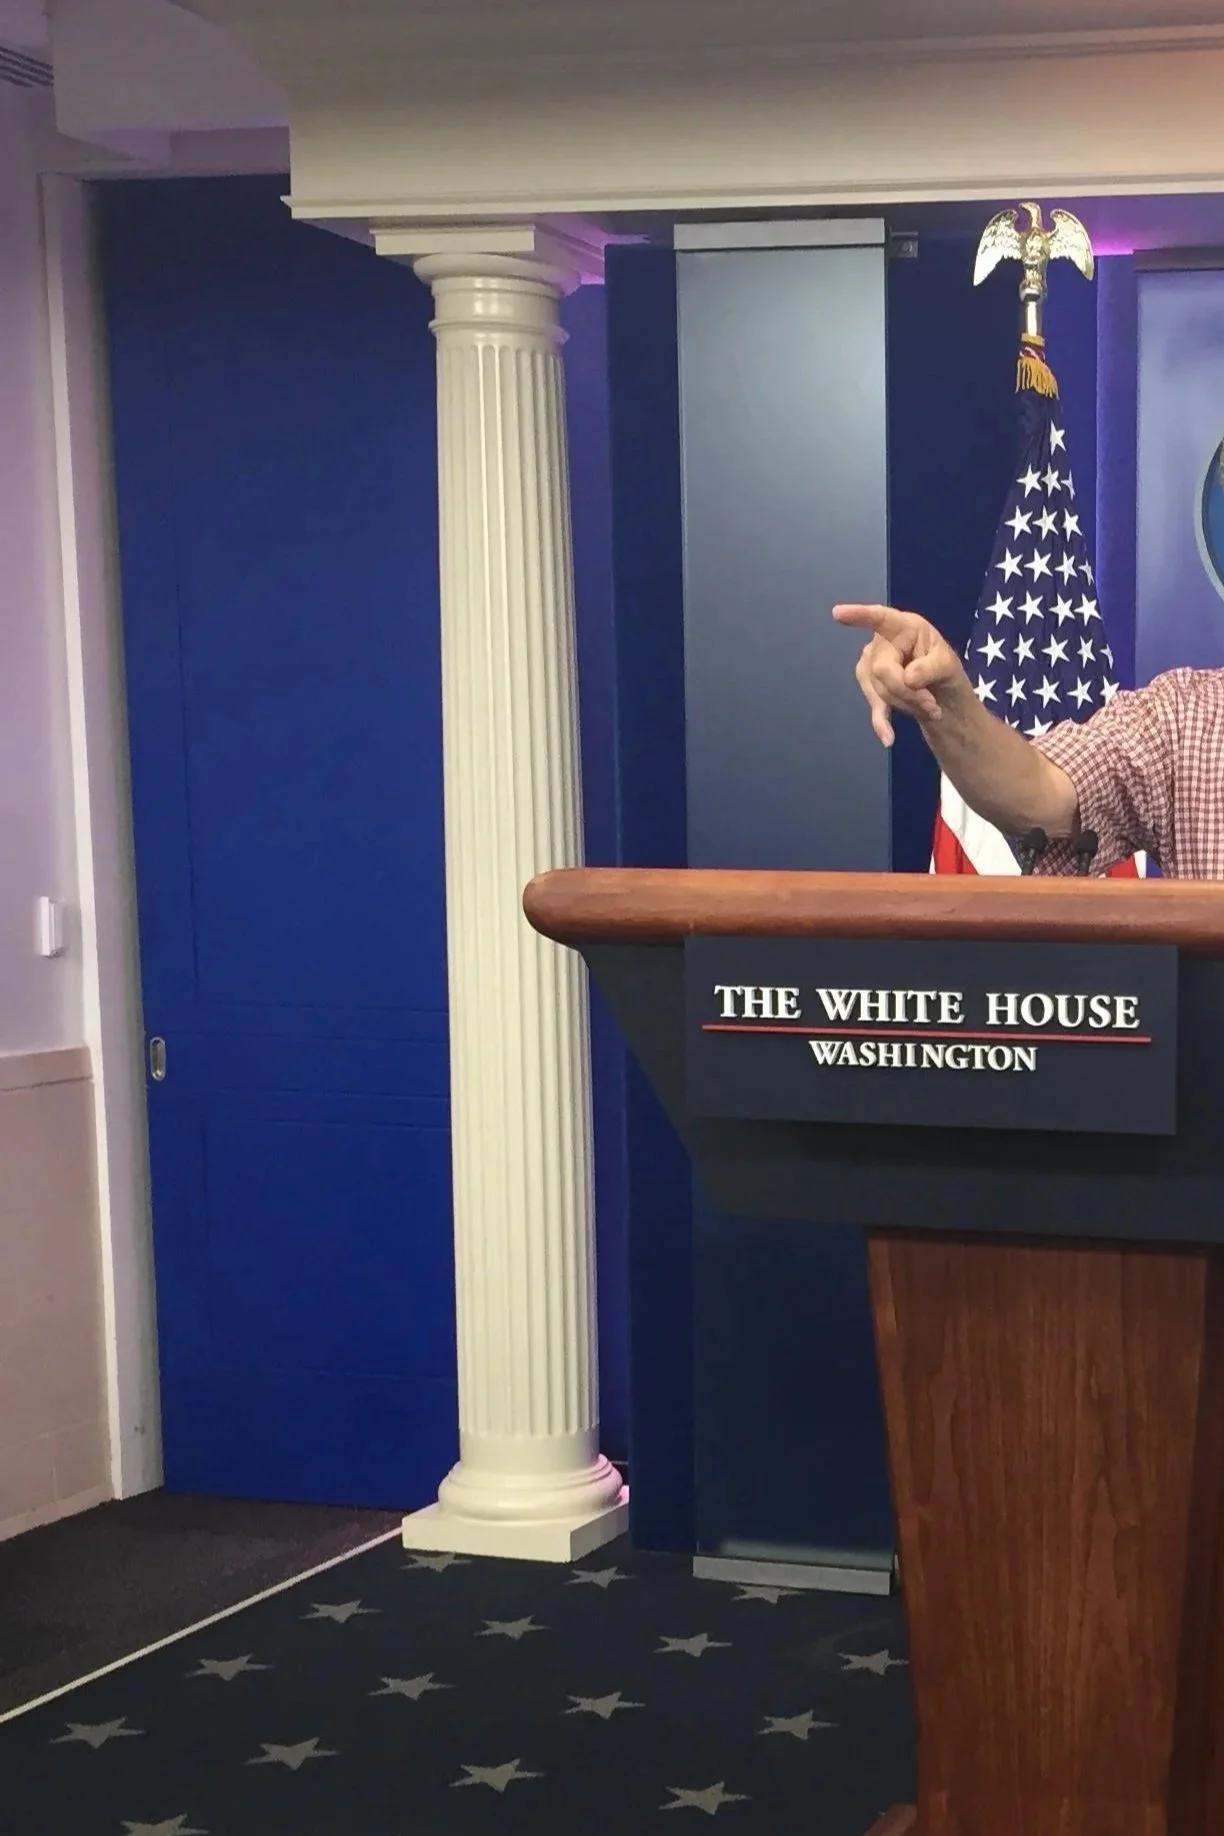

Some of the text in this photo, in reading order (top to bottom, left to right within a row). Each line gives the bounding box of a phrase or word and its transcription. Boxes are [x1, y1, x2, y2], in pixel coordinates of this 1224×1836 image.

[714, 985, 1140, 1028] THE WHITE HOUSE
[809, 1041, 1037, 1071] WASHINGTON
